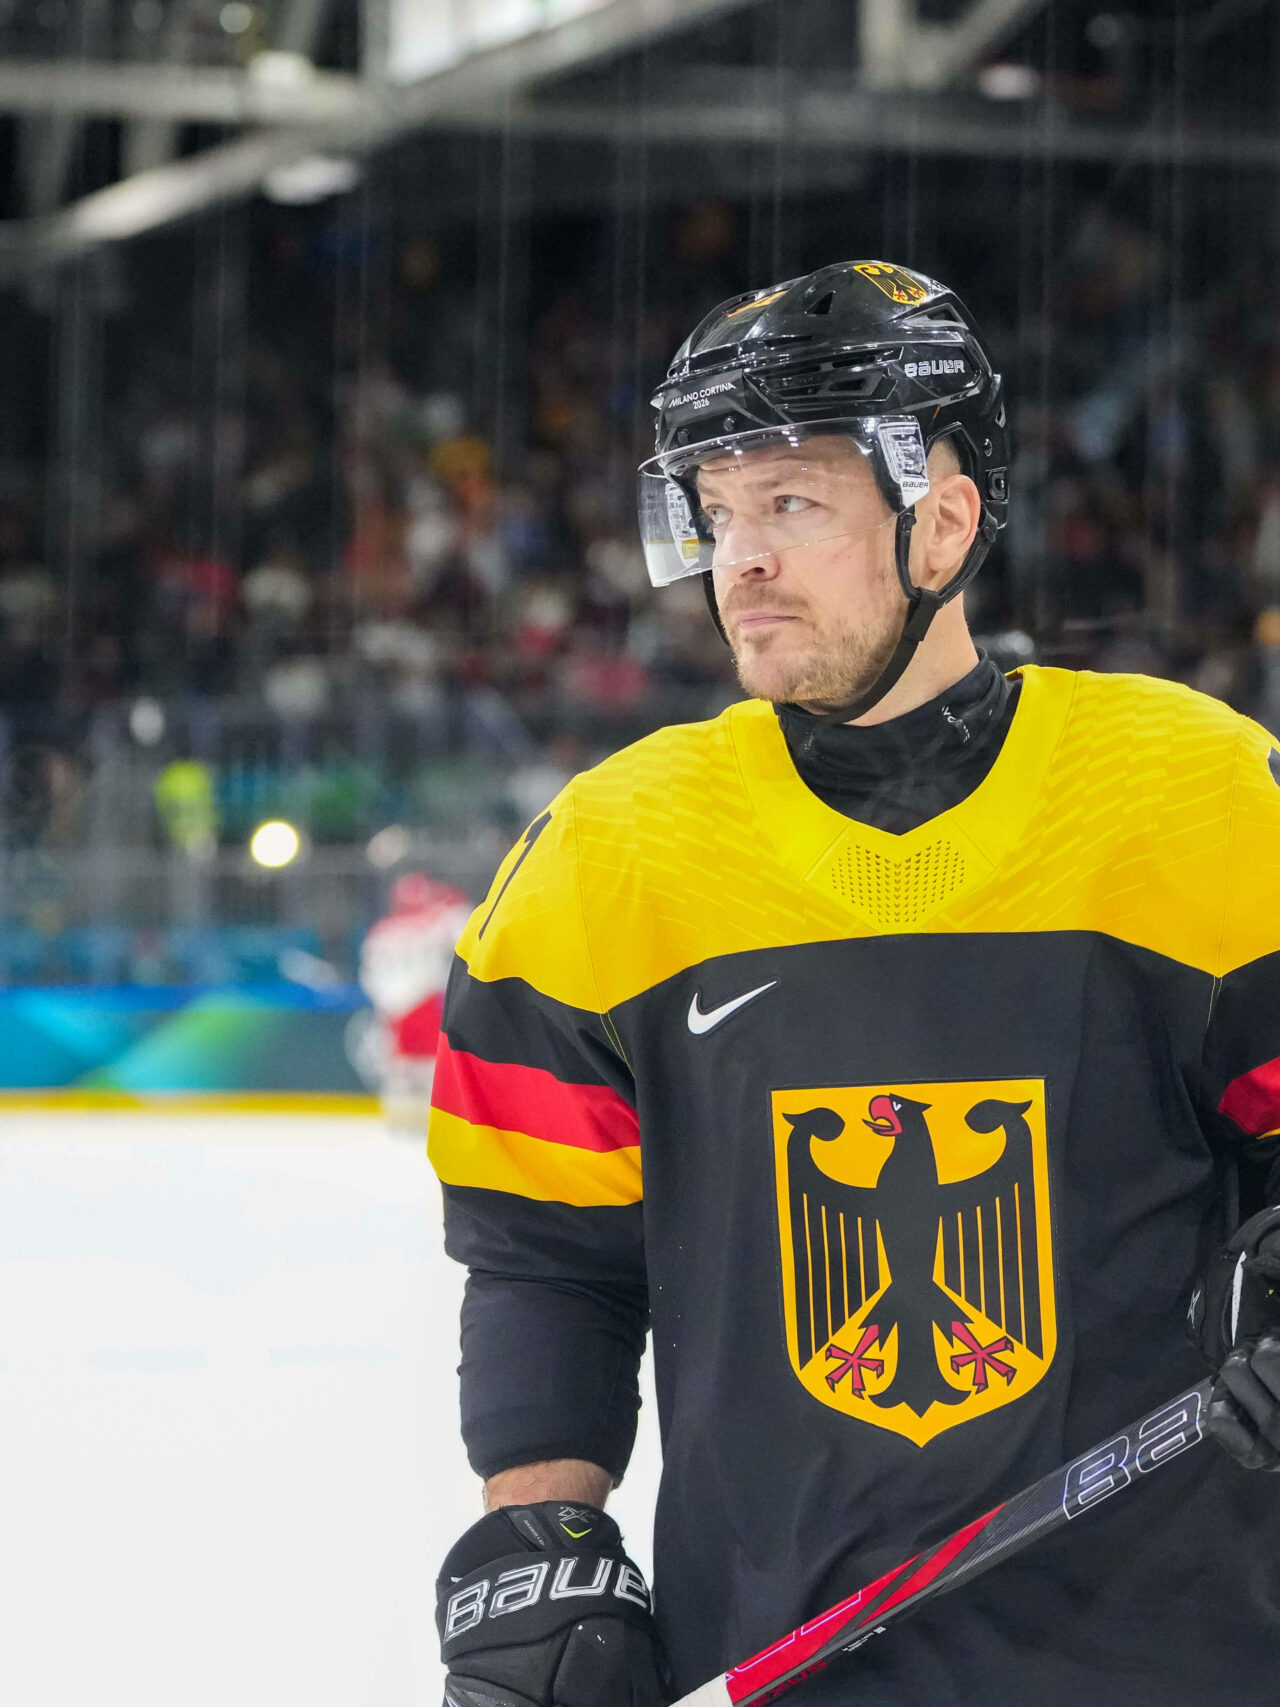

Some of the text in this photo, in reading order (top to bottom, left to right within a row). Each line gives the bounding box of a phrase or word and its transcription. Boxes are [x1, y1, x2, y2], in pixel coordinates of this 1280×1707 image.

[668, 382, 736, 408] MILANO CORTINA
[693, 398, 709, 409] 2026
[441, 1556, 654, 1645] BAUE
